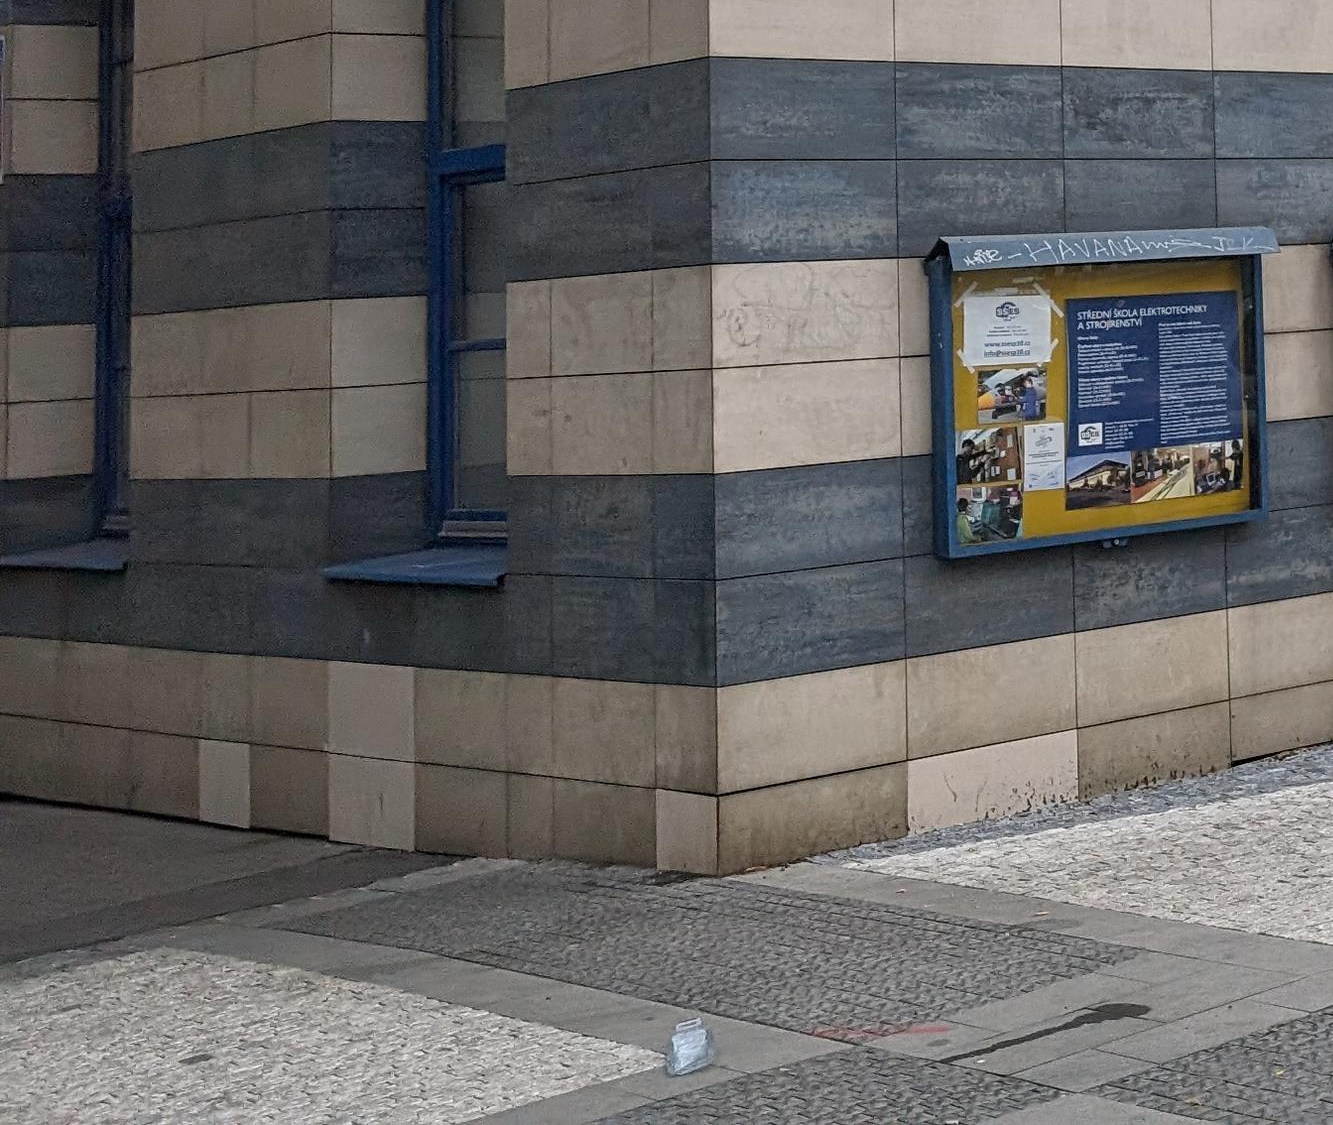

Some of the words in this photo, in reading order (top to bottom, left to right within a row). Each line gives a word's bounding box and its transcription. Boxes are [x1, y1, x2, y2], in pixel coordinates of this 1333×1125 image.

[1023, 235, 1143, 263] HAVANA
[1077, 309, 1112, 321] STŘEDNÍ
[1113, 307, 1139, 318] ŠKOLA
[1139, 304, 1208, 317] ELEKTROTECHNIKY
[1077, 321, 1085, 331] A
[1086, 318, 1143, 331] STROJÍRENSTVÍ
